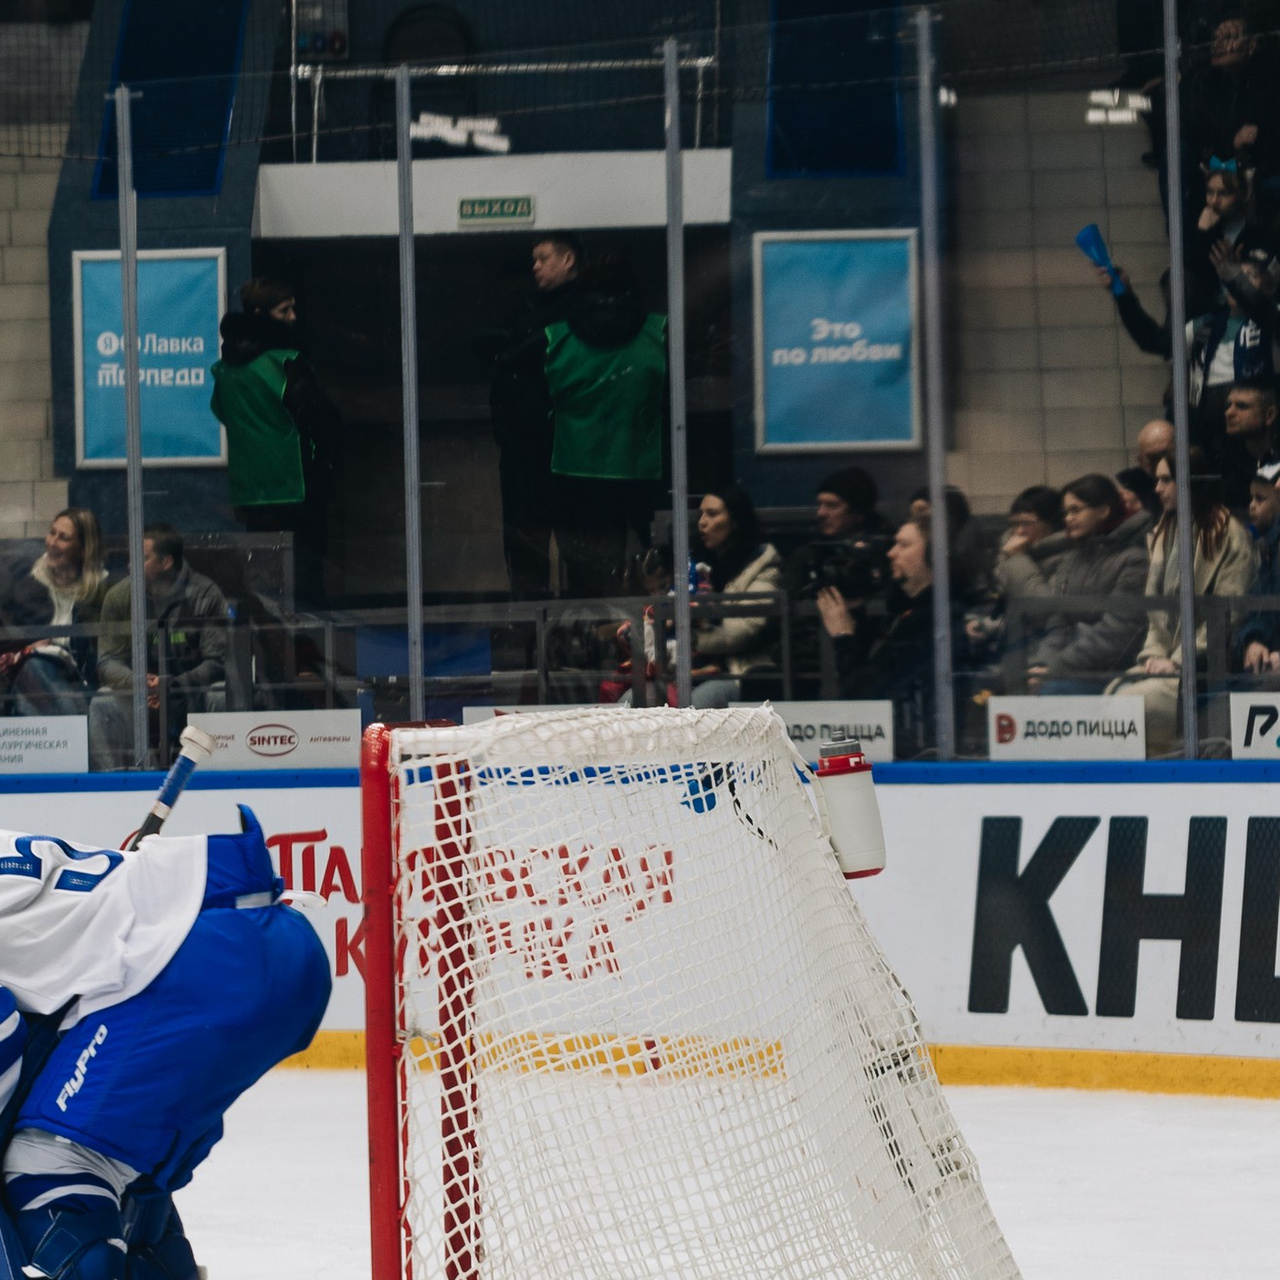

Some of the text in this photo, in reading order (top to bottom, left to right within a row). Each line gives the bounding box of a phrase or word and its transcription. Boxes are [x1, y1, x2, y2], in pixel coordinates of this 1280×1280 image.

[811, 318, 861, 340] Это
[144, 332, 204, 355] Лавка
[773, 340, 901, 365] по любви
[249, 734, 296, 746] SINTEC
[309, 735, 351, 744] АНТИФРИЗЫ
[1023, 719, 1138, 739] ДОДО ПИЦЦА
[55, 1024, 110, 1113] FlyPro
